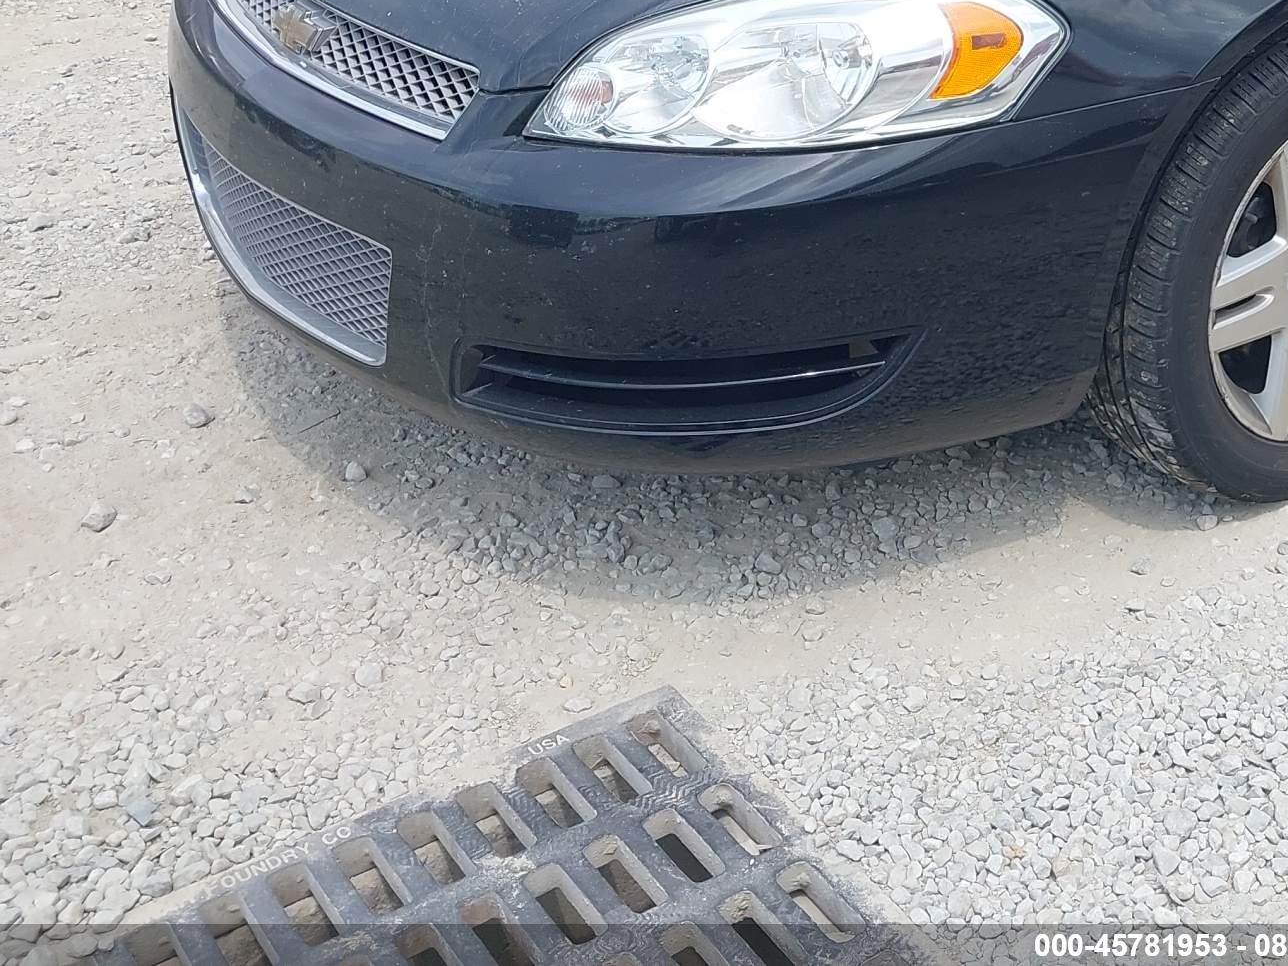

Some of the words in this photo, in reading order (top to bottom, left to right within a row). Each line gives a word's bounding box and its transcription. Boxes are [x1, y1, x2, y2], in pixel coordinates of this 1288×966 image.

[528, 734, 570, 754] USA
[204, 842, 311, 900] FOUNDRY
[322, 827, 351, 846] CO
